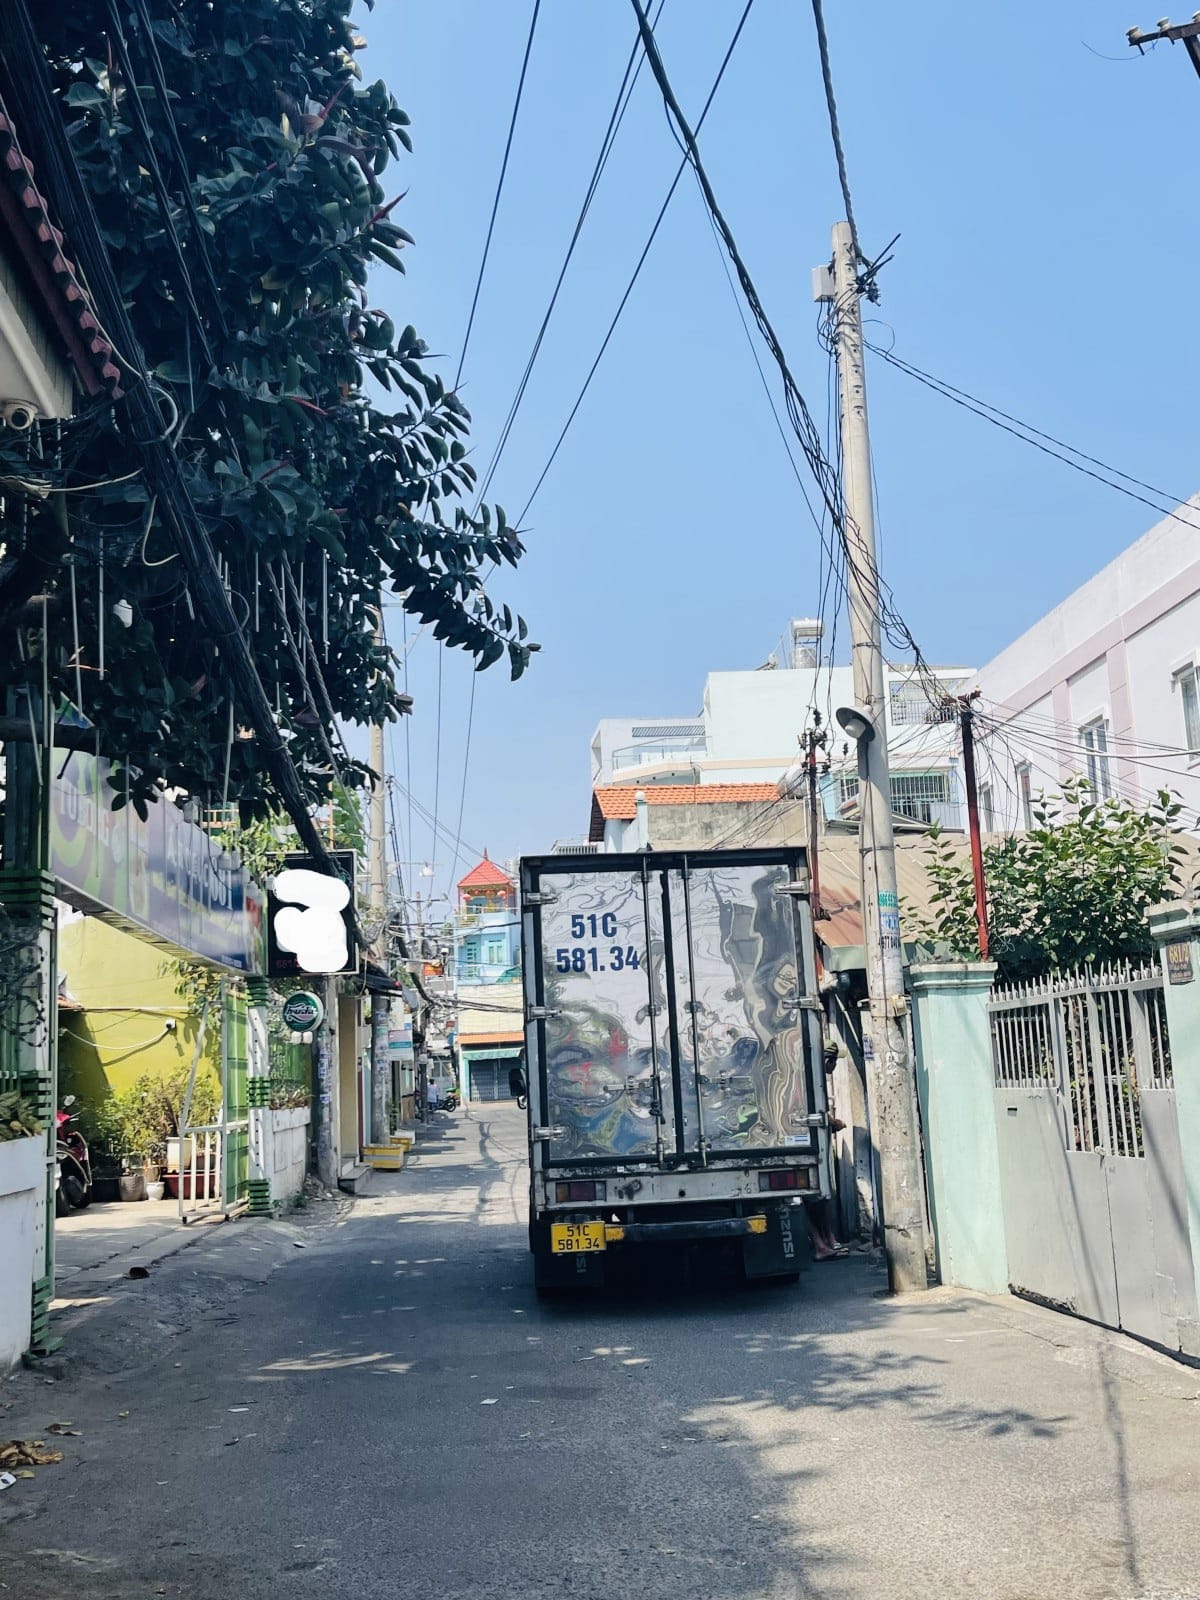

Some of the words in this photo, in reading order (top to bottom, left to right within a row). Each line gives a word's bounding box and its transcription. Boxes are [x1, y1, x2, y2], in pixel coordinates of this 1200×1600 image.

[571, 912, 617, 939] 51C
[556, 945, 640, 973] 581.34
[566, 1224, 590, 1237] 51C
[557, 1237, 600, 1251] 581.34
